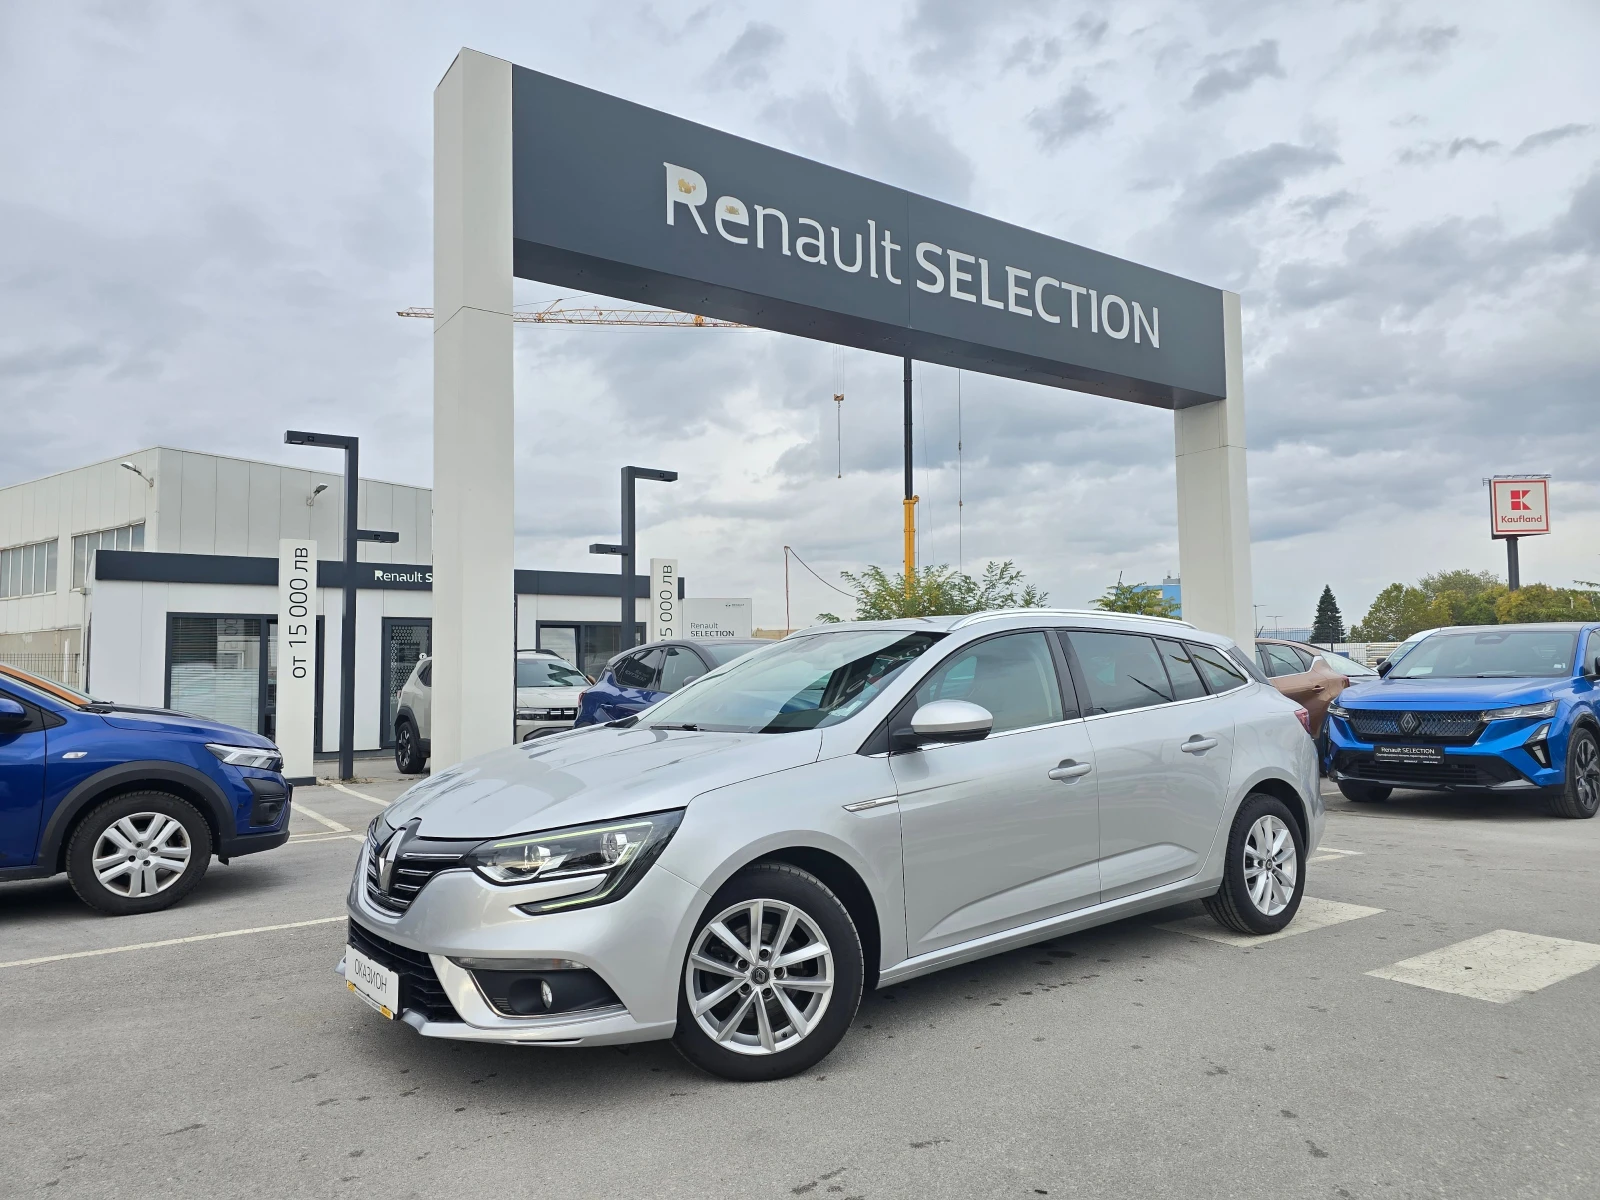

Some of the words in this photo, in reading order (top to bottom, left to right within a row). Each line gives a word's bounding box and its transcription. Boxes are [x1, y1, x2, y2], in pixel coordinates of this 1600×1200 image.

[663, 161, 902, 285] Renault
[915, 241, 1160, 349] SELECTION
[1501, 515, 1543, 523] Kaufland
[294, 547, 308, 572] лв
[374, 570, 423, 582] Renault
[662, 565, 673, 586] лв
[288, 578, 308, 618] 000
[659, 590, 673, 622] 000
[288, 624, 307, 648] 15
[660, 627, 673, 641] 5
[292, 656, 307, 679] от
[355, 959, 388, 993] ОКАЗИОН
